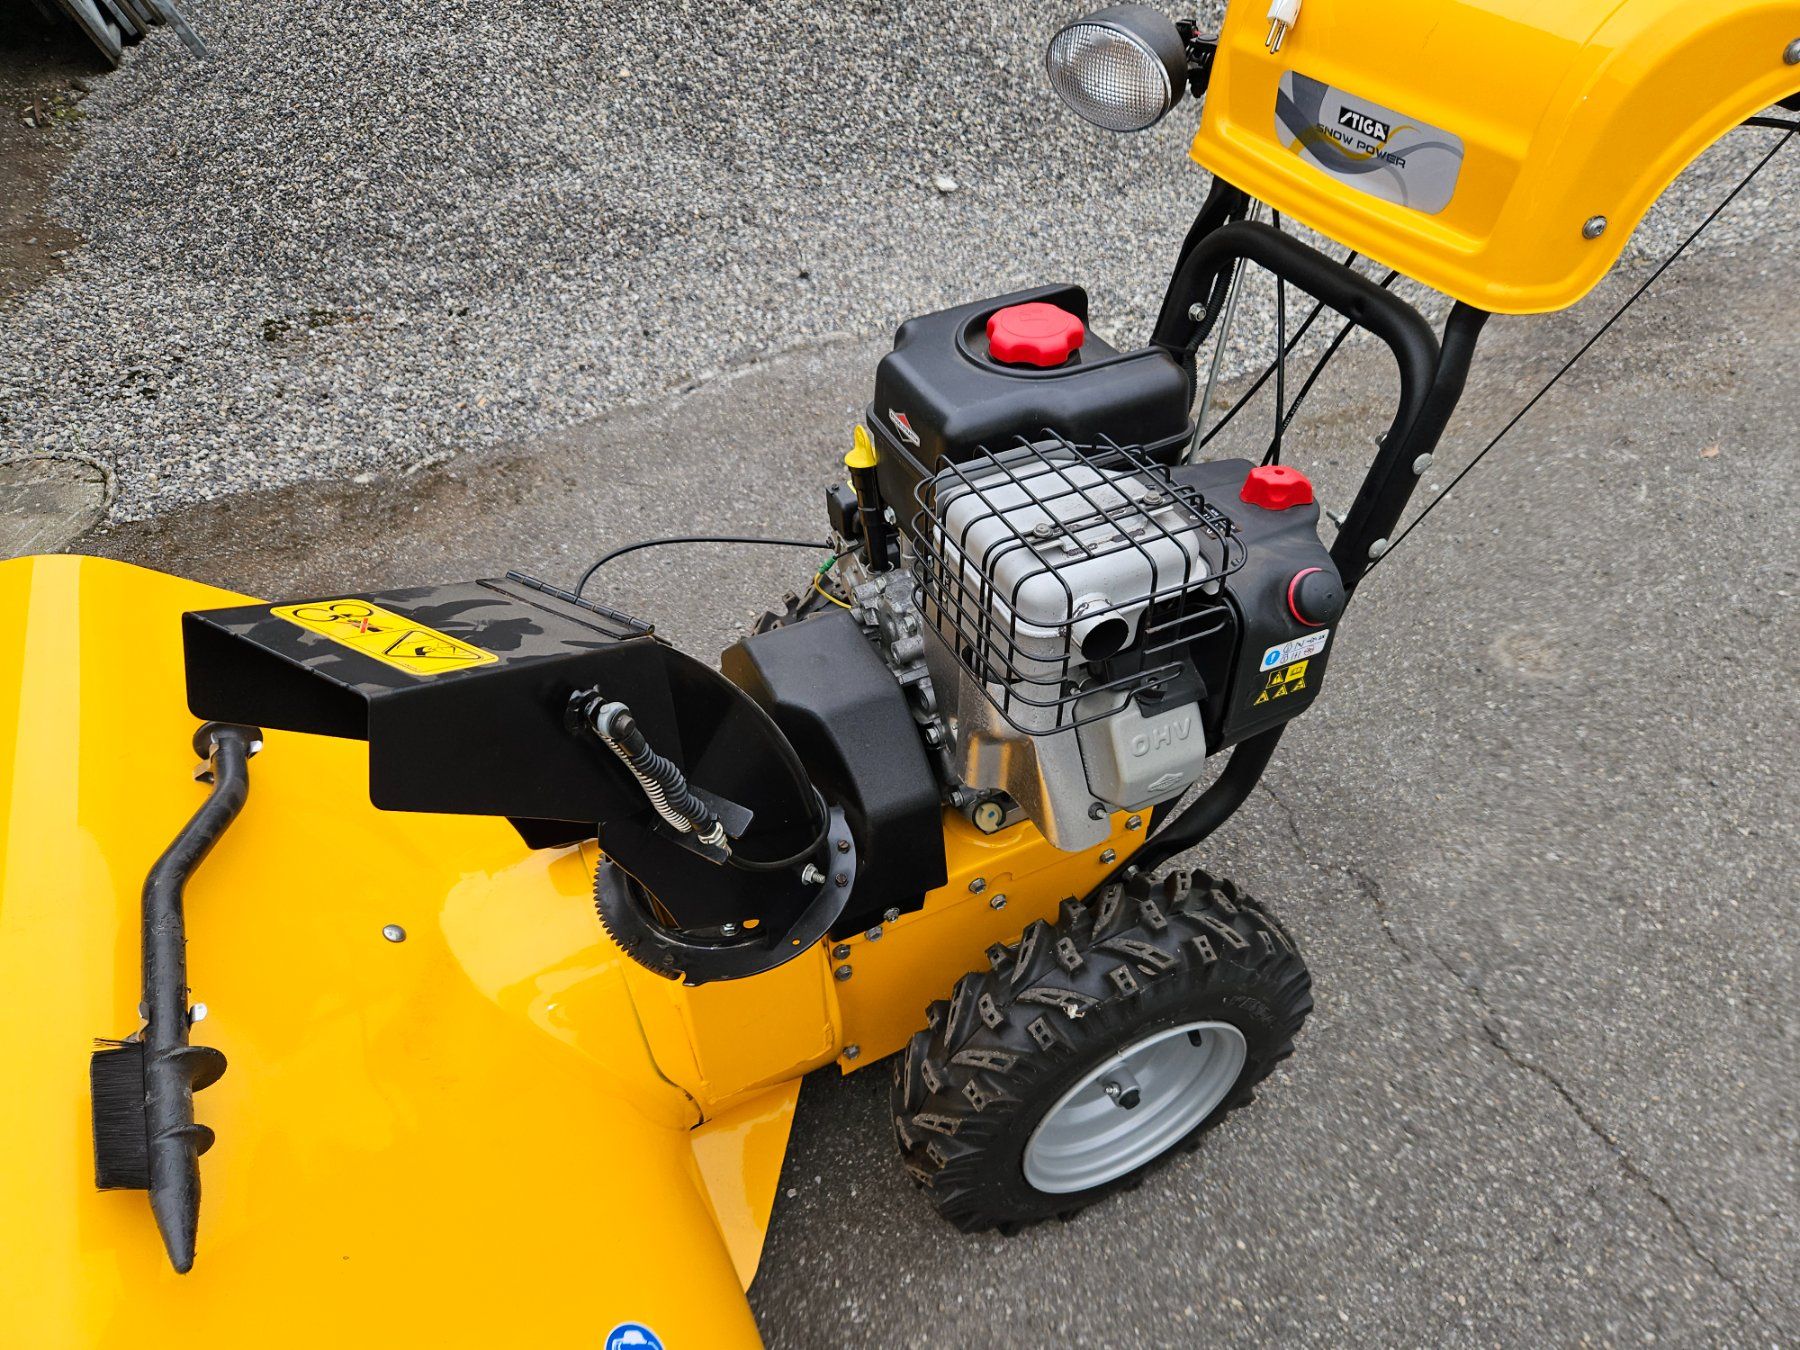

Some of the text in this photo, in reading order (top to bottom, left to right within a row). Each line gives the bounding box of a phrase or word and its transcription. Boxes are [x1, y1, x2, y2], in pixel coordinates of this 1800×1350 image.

[1317, 123, 1406, 169] SNOW POWER
[1340, 111, 1386, 141] STIGA
[1131, 716, 1191, 758] OHV
